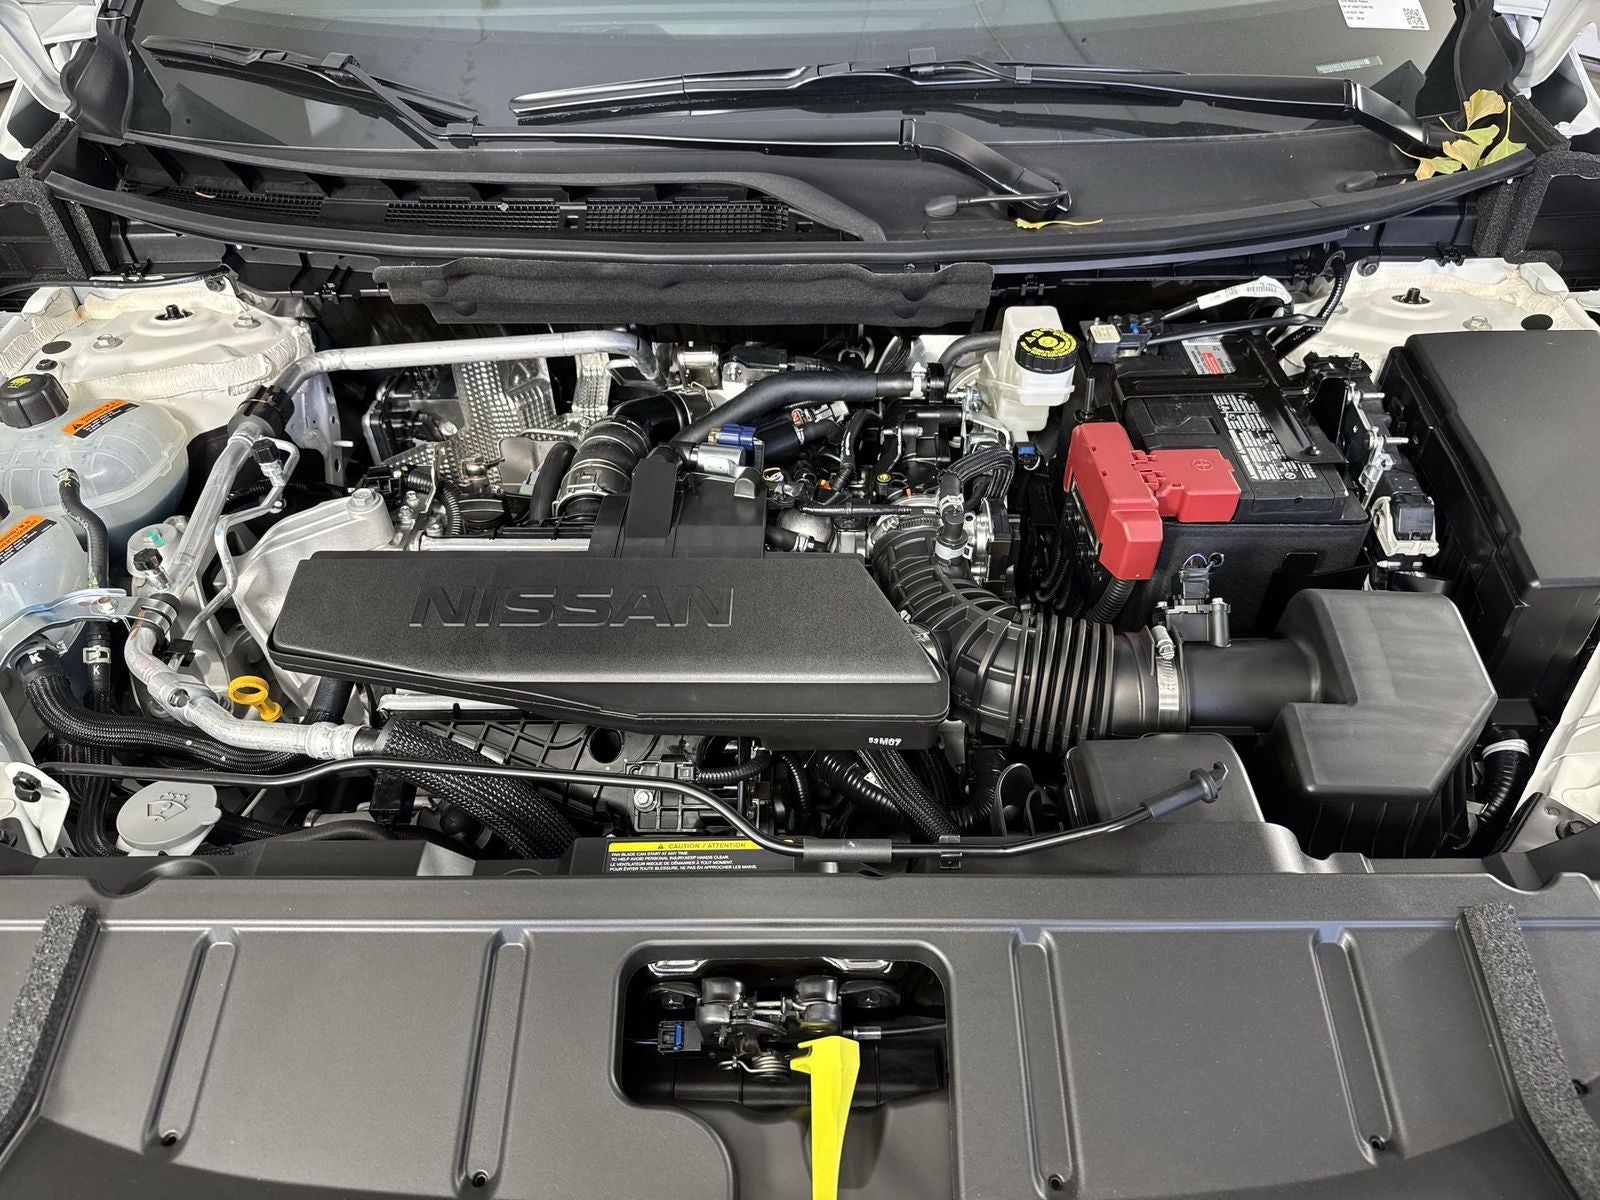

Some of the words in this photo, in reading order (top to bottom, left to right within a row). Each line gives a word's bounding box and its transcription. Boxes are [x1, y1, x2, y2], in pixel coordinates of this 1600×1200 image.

[409, 587, 734, 627] NISSAN
[28, 652, 43, 664] K
[93, 664, 101, 675] K
